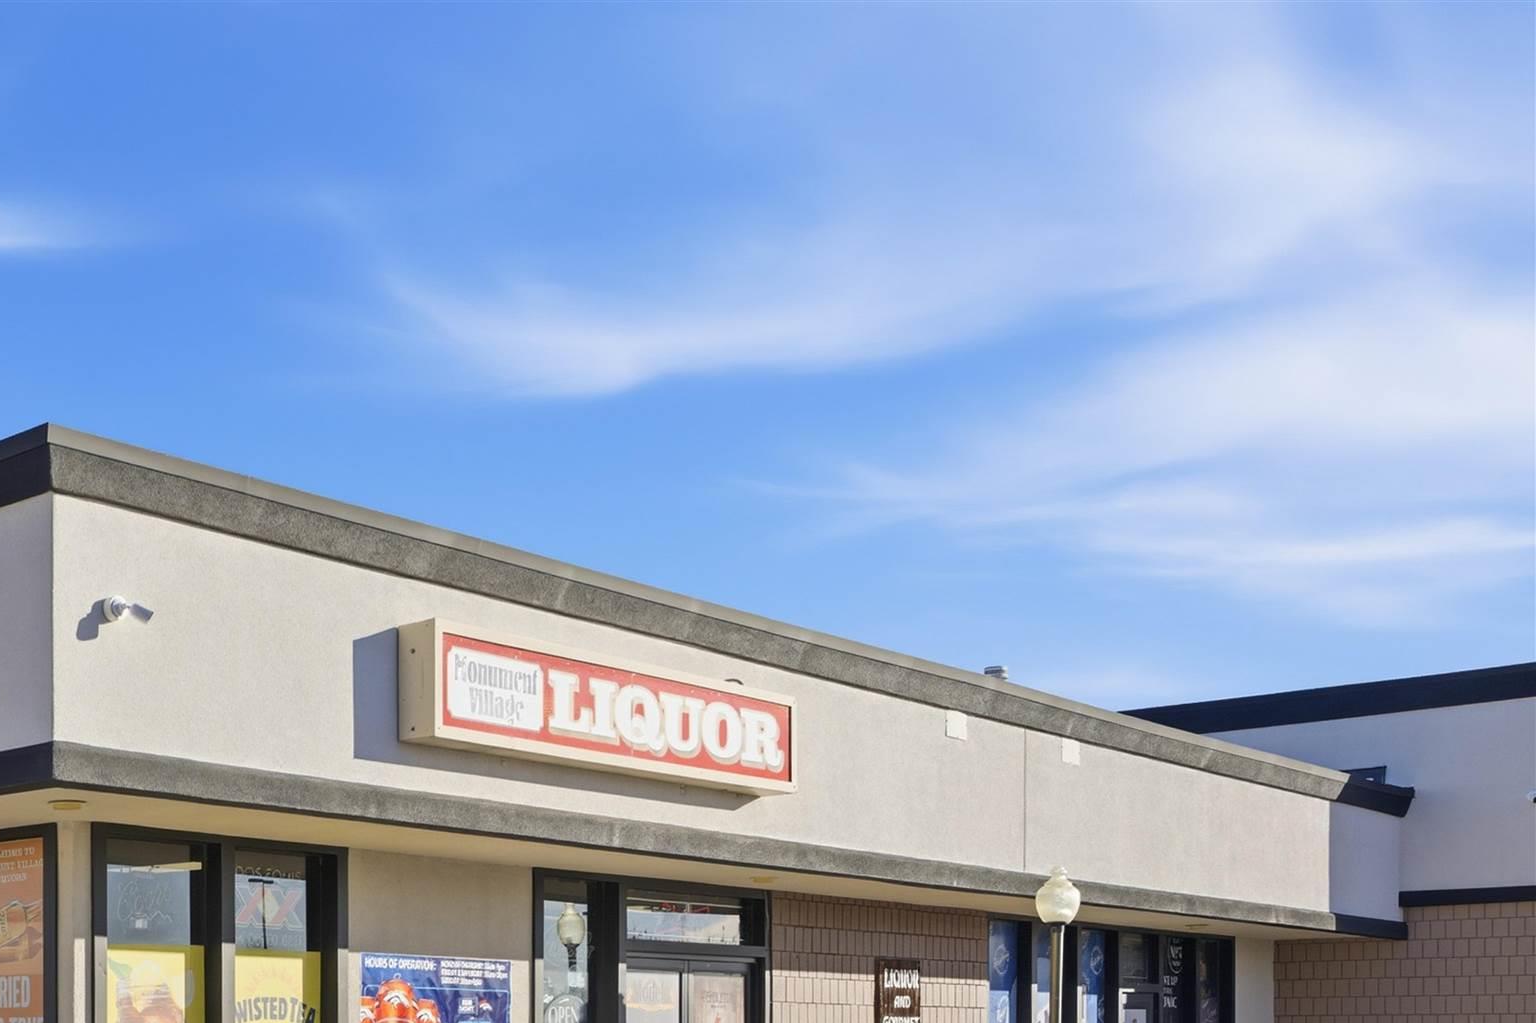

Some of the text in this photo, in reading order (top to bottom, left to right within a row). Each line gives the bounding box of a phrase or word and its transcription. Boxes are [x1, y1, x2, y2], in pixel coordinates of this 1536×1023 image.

[454, 653, 539, 696] Monument
[469, 687, 525, 725] Village
[548, 668, 785, 772] LIQUOR
[884, 968, 920, 989] LIQUOR
[894, 995, 912, 1009] AND
